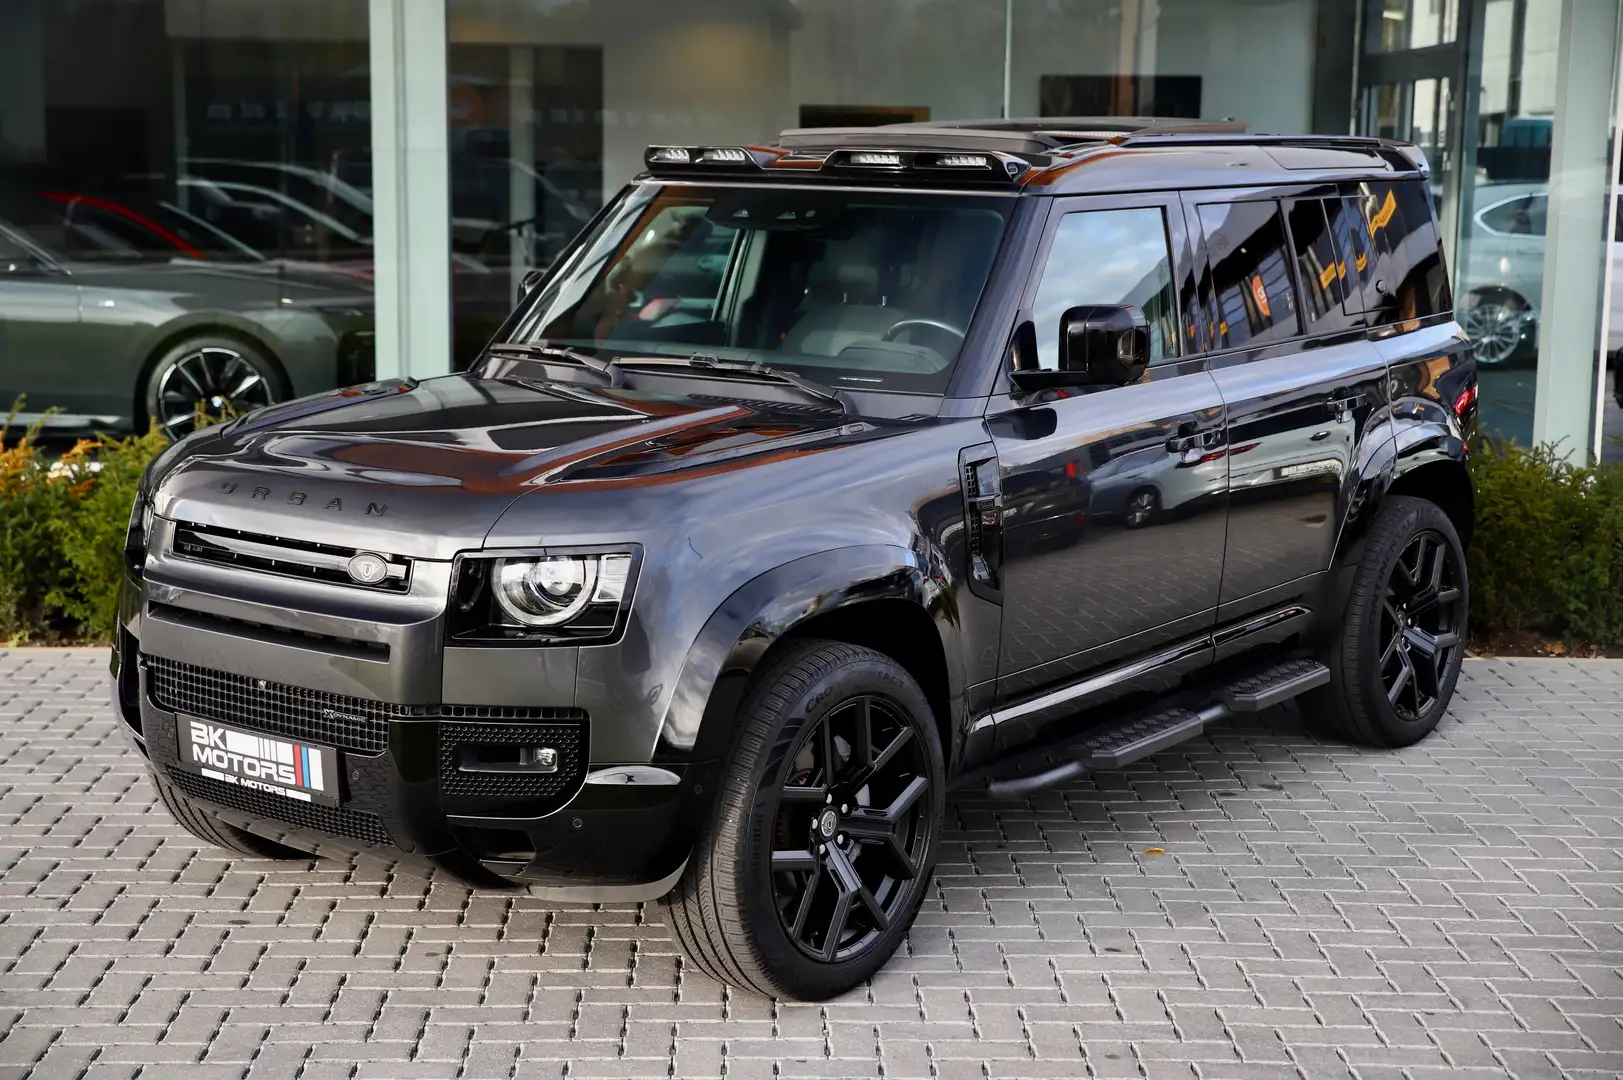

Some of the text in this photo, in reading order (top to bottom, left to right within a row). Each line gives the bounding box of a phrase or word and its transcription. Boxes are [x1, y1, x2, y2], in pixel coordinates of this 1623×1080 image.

[218, 482, 390, 516] URBAN
[190, 721, 228, 750] BK
[192, 743, 296, 785] MOTORS
[224, 773, 286, 796] BK MOTORS
